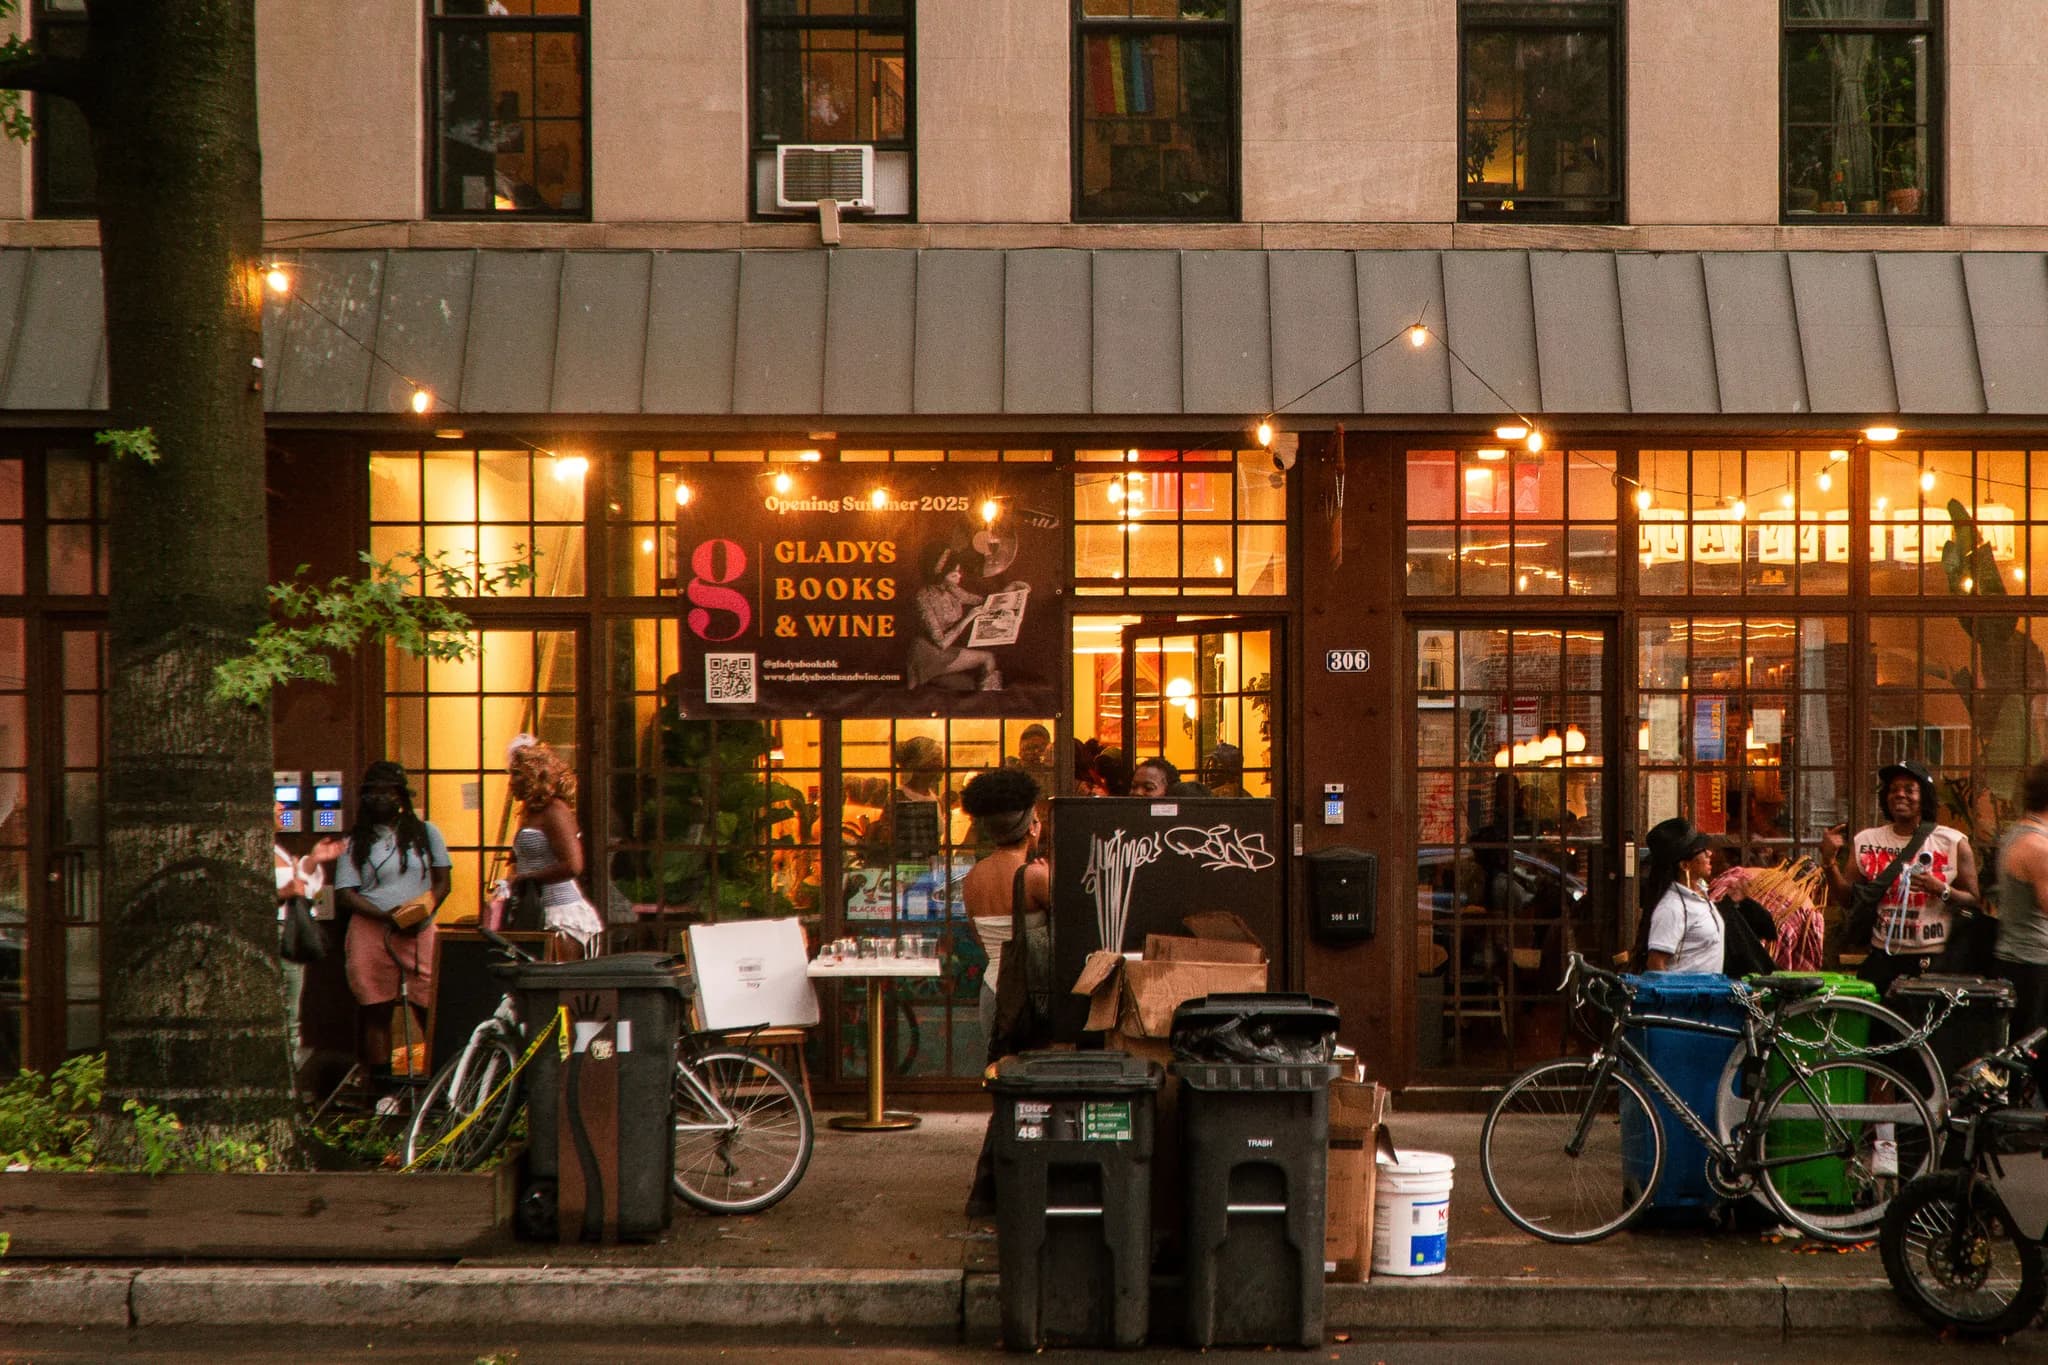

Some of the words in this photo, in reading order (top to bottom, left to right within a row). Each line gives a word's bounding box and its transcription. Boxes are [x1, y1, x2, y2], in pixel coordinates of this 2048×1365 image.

[765, 496, 839, 514] Opening
[921, 496, 969, 511] 2025
[774, 541, 896, 563] GLADYS
[775, 577, 895, 600] BOOKS
[774, 615, 798, 637] &
[804, 615, 895, 637] WINE
[763, 660, 839, 669] @gladysbooksbk
[1331, 652, 1366, 669] 306
[763, 673, 900, 682] www.gladysbooksandwine.com
[1711, 777, 1721, 812] LAZIZA
[1018, 1103, 1051, 1113] Toter
[1248, 1139, 1273, 1148] TRASH
